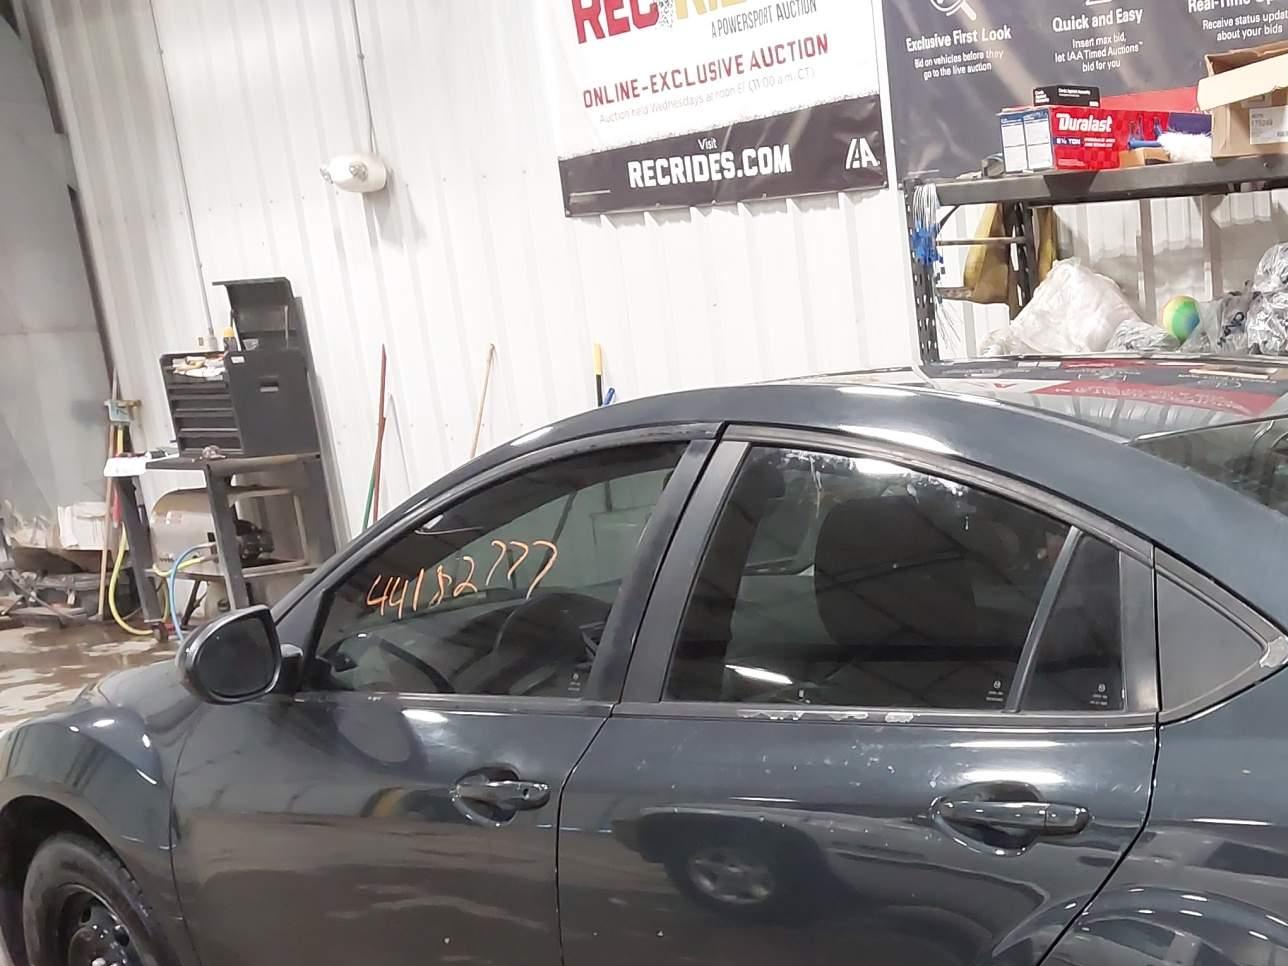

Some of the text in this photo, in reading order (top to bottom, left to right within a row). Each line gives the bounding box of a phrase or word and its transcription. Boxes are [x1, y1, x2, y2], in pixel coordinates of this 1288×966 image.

[718, 5, 774, 37] POWERSPORT
[776, 0, 818, 24] AUCTION
[1052, 8, 1144, 32] Quick and Easy
[1202, 18, 1234, 30] Receive
[1234, 14, 1261, 26] status
[905, 24, 1012, 52] Exclusive First Look
[1072, 31, 1127, 49] Insert max bid,
[1216, 23, 1283, 41] about your bids
[914, 49, 1004, 69] Bid on vehicles before they
[1054, 52, 1066, 63] let
[1067, 50, 1084, 61] IAA
[1084, 47, 1107, 60] Timed
[583, 33, 829, 109] ONLINE-EXCLUSIVE AUCTION
[923, 62, 992, 81] go to the live auction
[1082, 59, 1121, 73] bid for you
[1056, 113, 1113, 132] Duralast
[698, 137, 718, 151] Visit
[627, 144, 792, 189] RECRIDES.COM
[366, 539, 559, 620] 44182777
